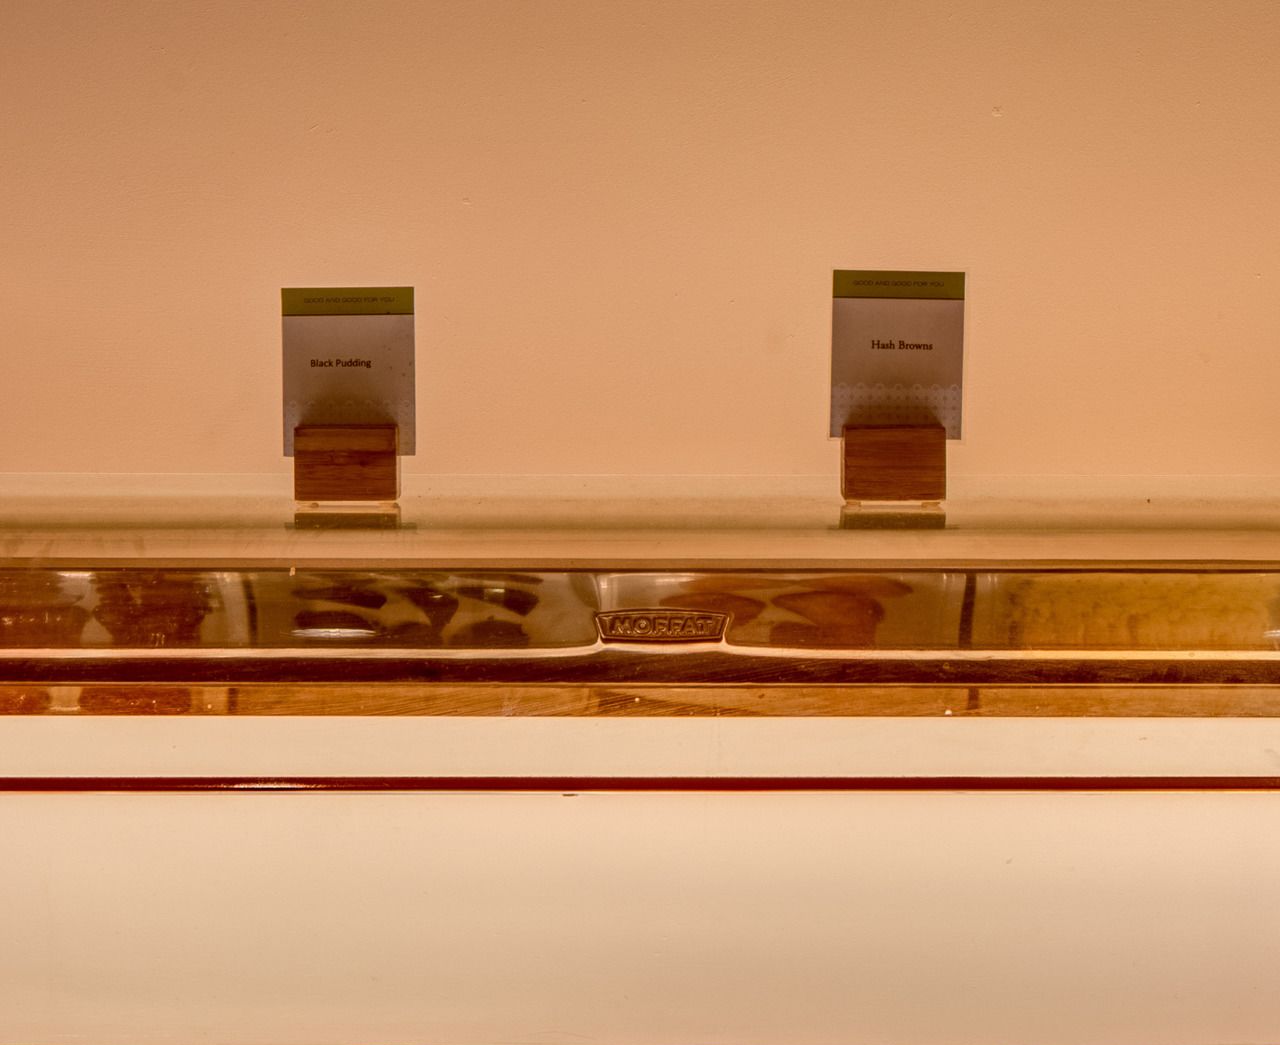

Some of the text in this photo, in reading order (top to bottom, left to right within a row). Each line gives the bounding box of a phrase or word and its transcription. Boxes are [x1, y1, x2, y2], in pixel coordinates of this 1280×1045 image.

[871, 340, 933, 350] Hash Browns
[310, 359, 371, 368] Black Pudding
[612, 616, 713, 634] MOFFAT
